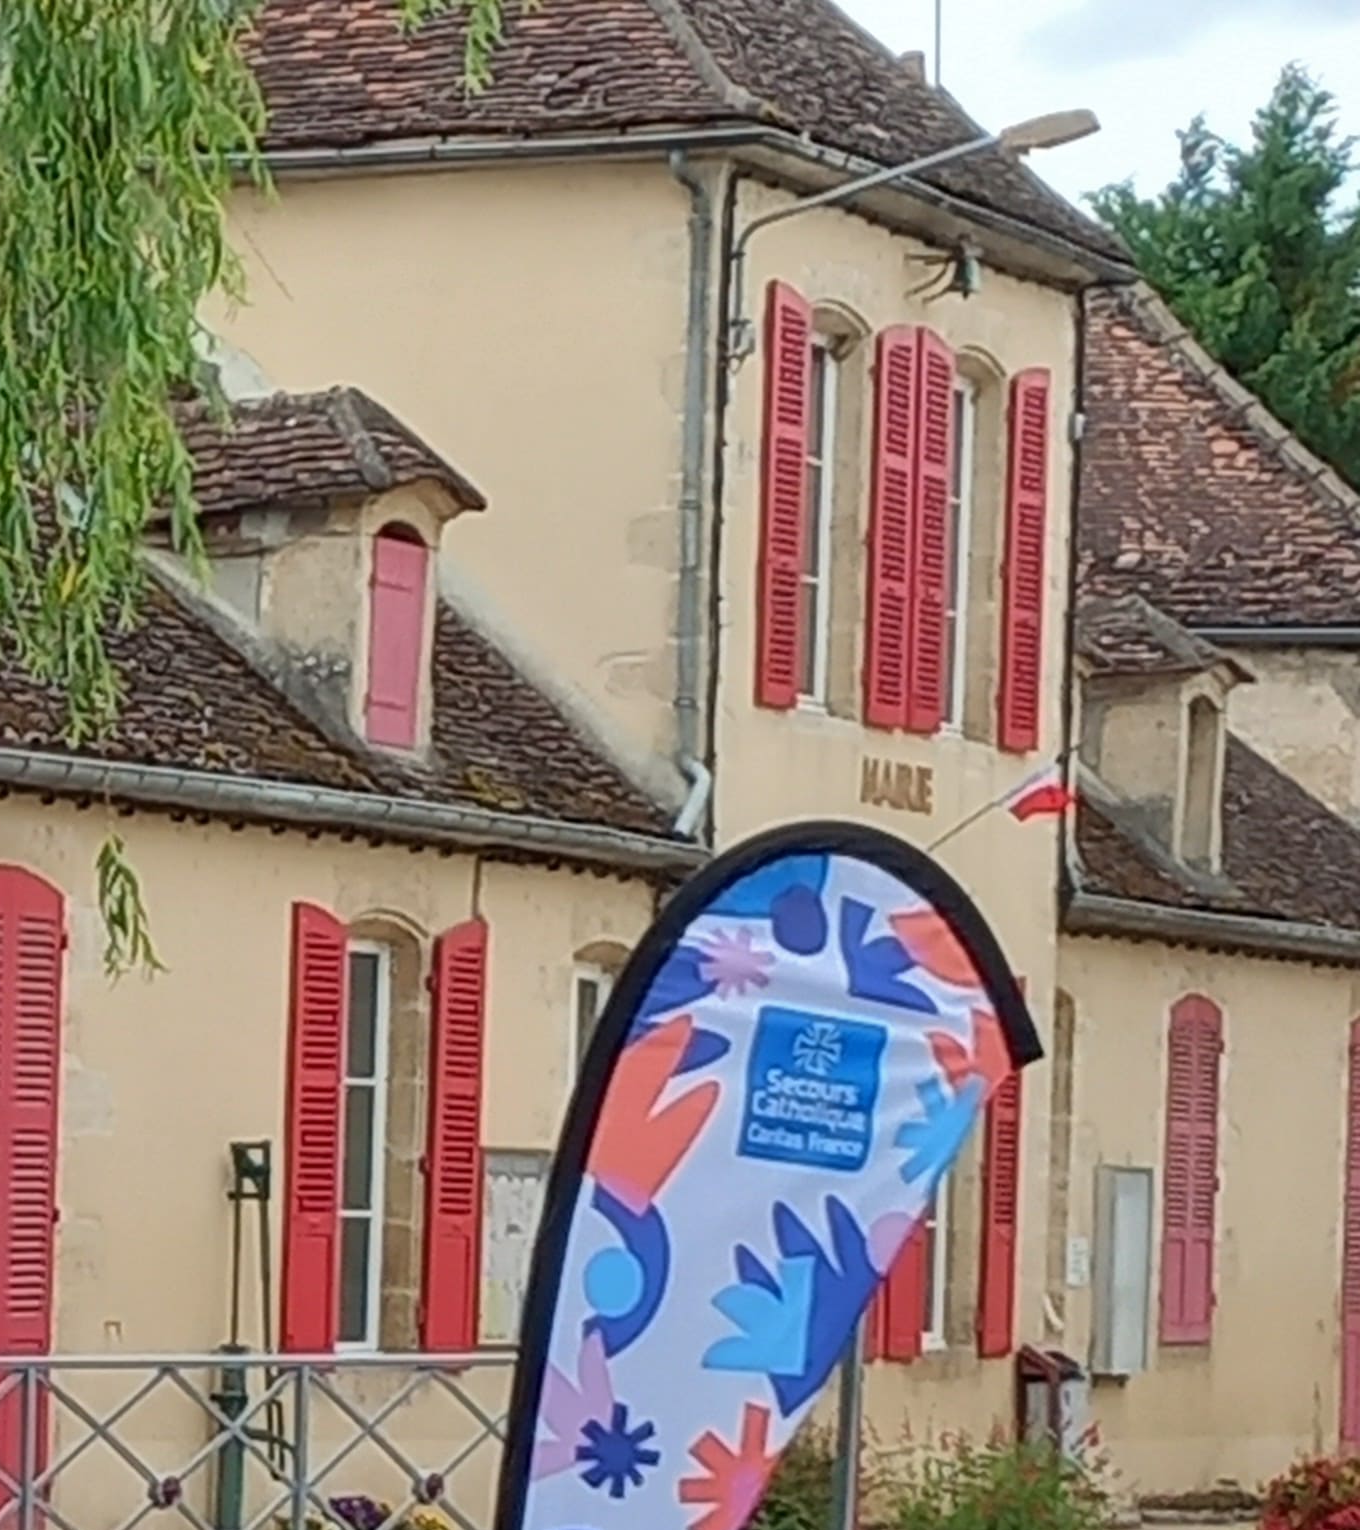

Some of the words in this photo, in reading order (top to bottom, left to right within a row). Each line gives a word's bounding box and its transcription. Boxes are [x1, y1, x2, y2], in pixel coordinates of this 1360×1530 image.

[766, 1068, 859, 1106] Secours
[752, 1090, 866, 1132] Catholique
[747, 1122, 804, 1150] Caritas
[808, 1131, 864, 1157] France
